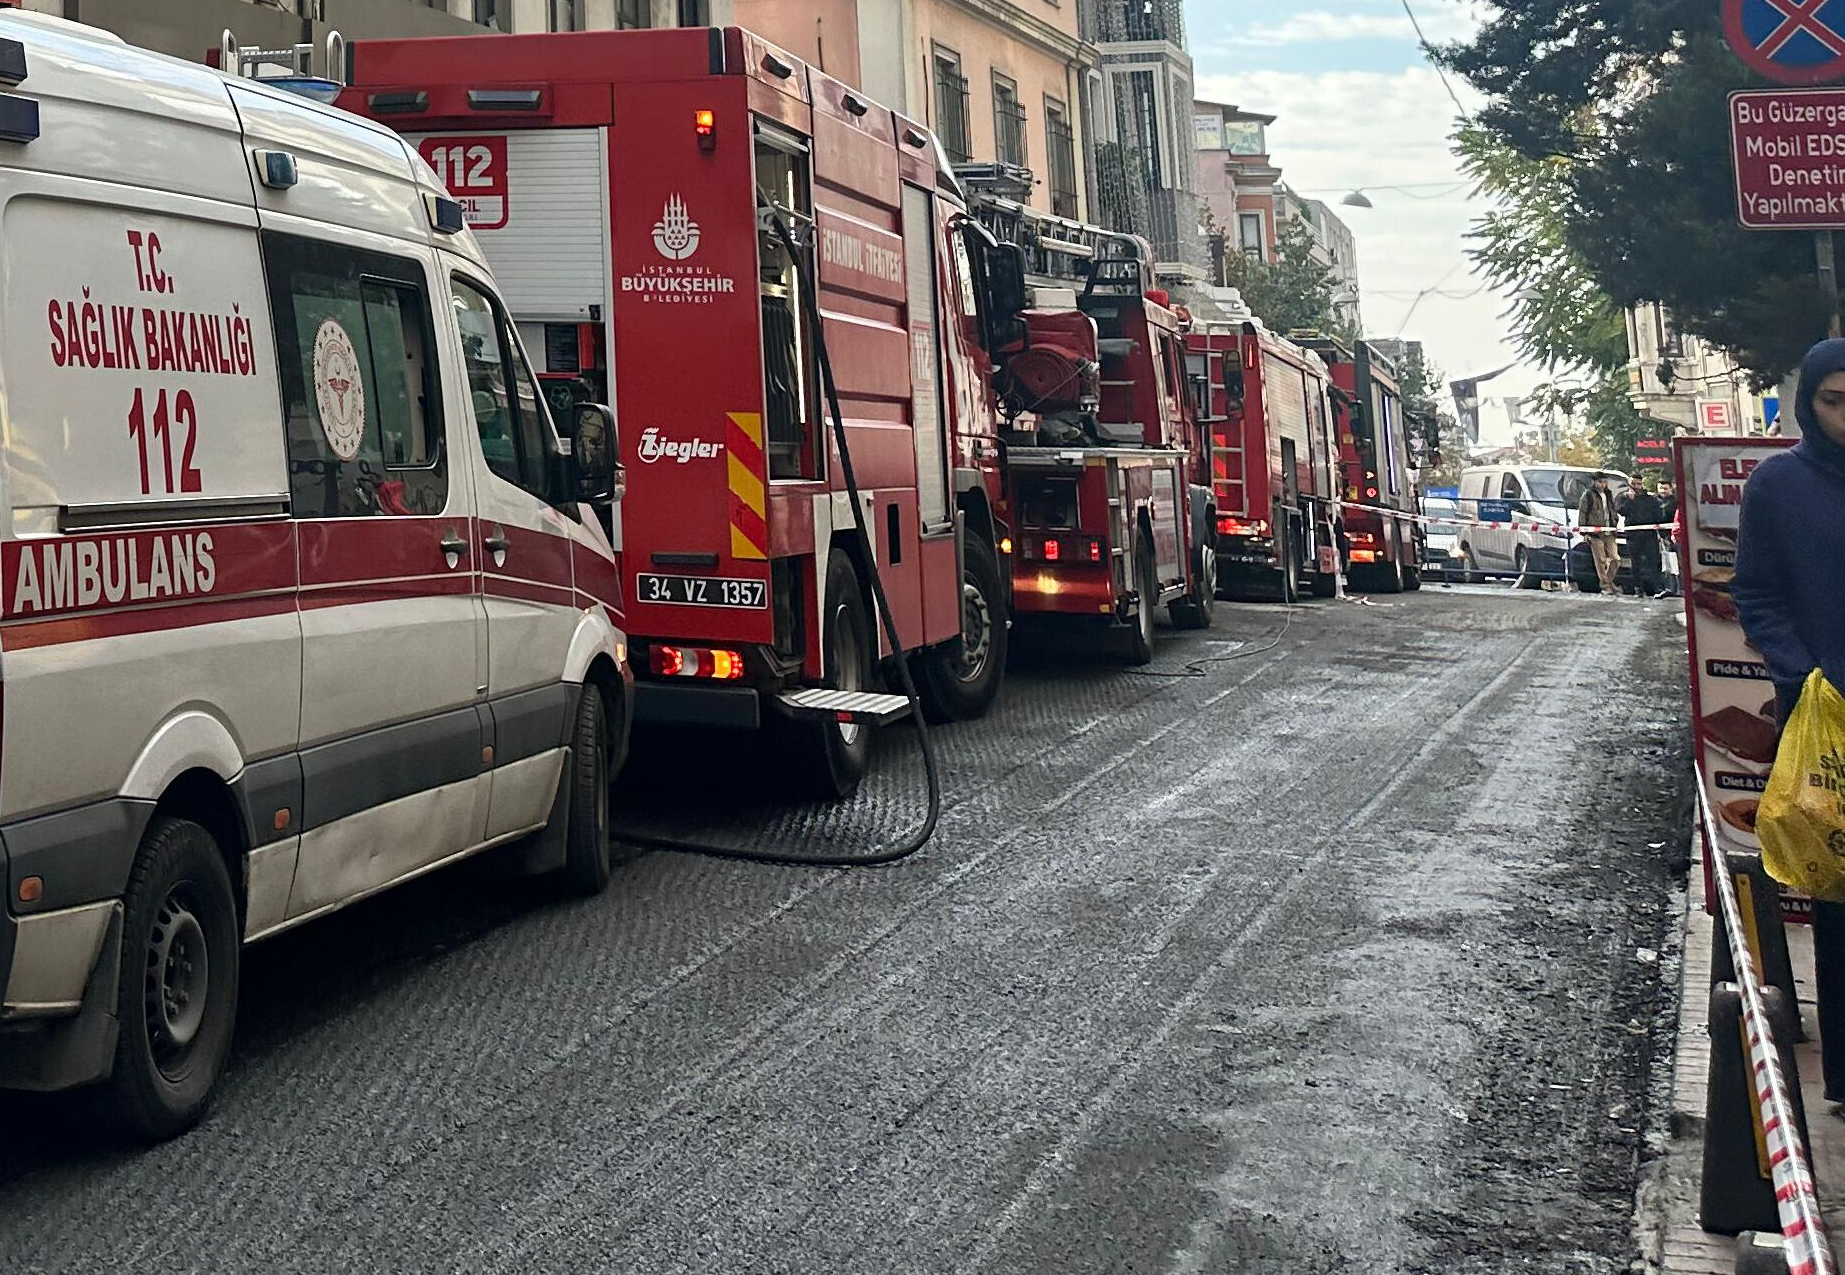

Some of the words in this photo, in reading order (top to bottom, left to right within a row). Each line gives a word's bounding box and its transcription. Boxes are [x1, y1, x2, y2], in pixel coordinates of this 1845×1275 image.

[1737, 102, 1763, 123] Bu
[1746, 135, 1802, 157] Mobil
[1806, 134, 1845, 156] EDS
[432, 145, 493, 187] 112
[127, 230, 174, 294] T.C.
[823, 228, 864, 272] İSTANBUL
[642, 265, 712, 274] İSTANBUL
[621, 273, 735, 294] BÜYÜKŞEHİR
[643, 294, 713, 303] BLEDİYESİ
[48, 286, 140, 370] SAĞLIK
[141, 302, 256, 376] BAKANLIĞI
[1706, 406, 1725, 424] E
[128, 387, 202, 495] 112
[638, 427, 724, 463] Ziegler
[1705, 551, 1737, 564] Dürü
[13, 532, 216, 614] AMBULANS
[648, 578, 672, 600] 34
[683, 579, 708, 602] VZ
[721, 582, 764, 605] 1357
[1713, 663, 1740, 674] Pide
